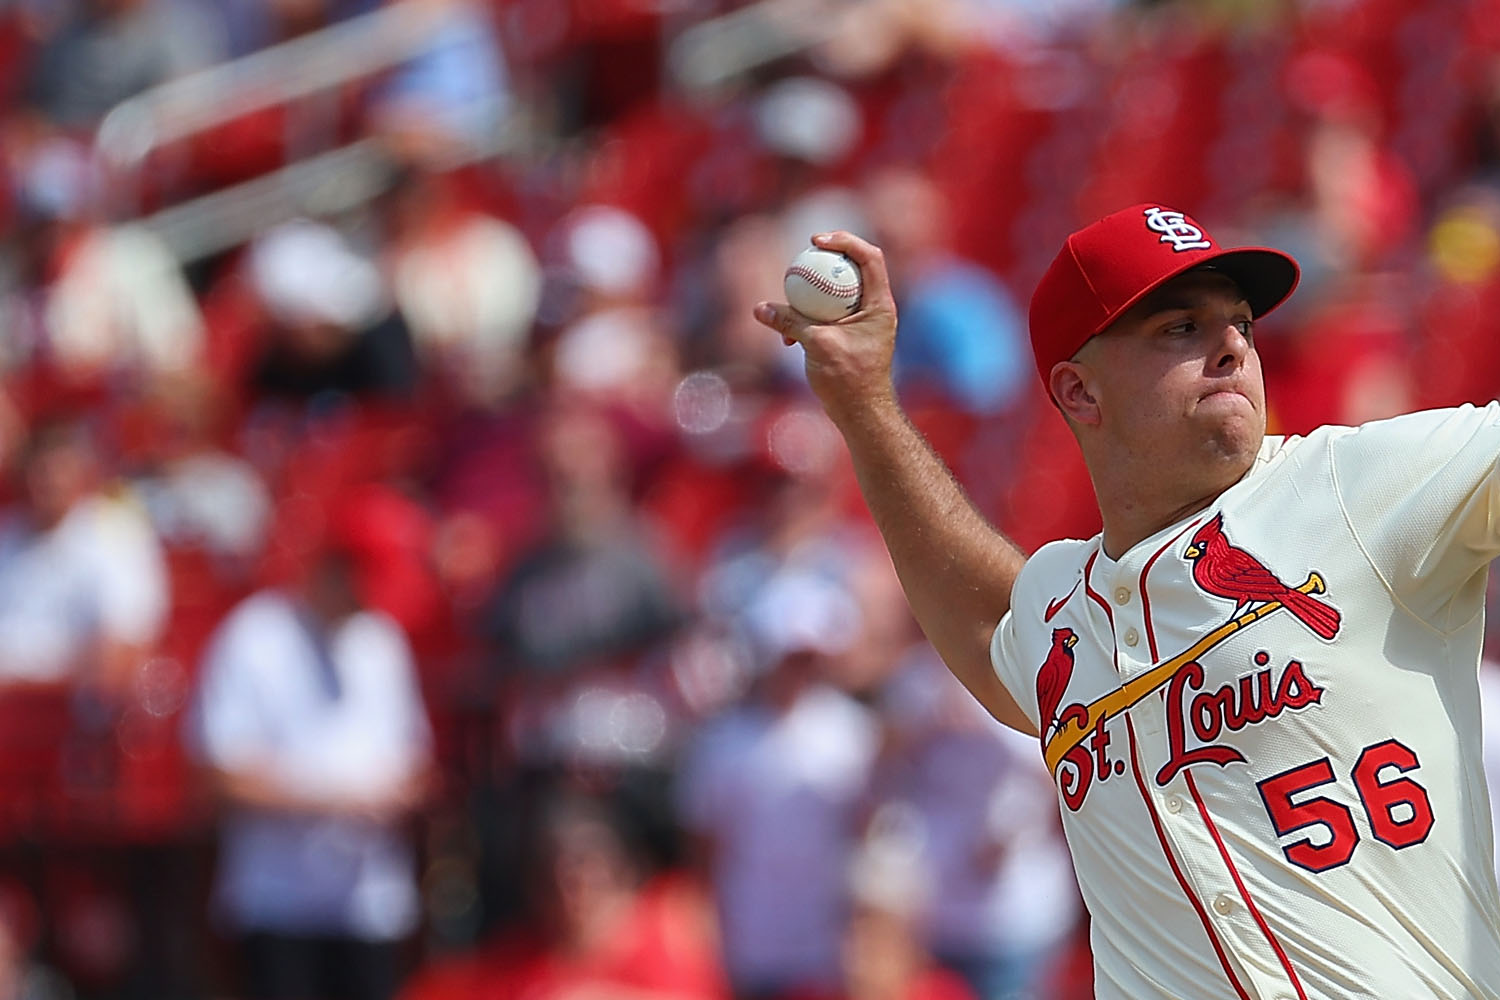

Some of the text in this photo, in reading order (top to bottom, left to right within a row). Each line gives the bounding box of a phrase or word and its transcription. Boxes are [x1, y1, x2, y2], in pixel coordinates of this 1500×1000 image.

[1060, 650, 1324, 812] St. Louis
[1256, 738, 1436, 874] 56
